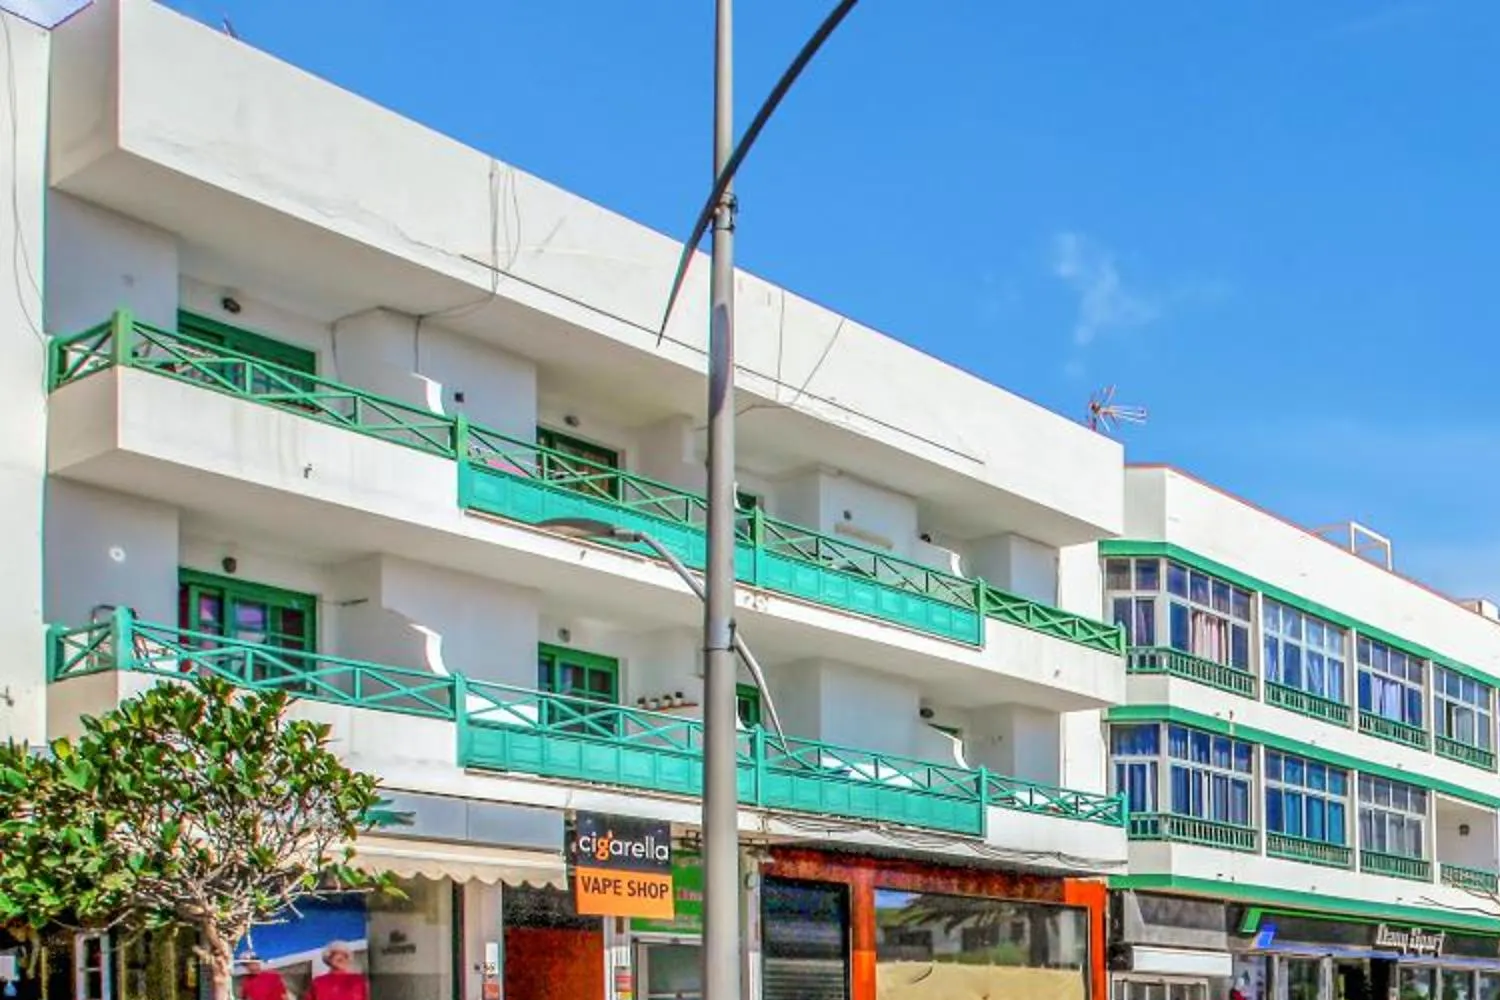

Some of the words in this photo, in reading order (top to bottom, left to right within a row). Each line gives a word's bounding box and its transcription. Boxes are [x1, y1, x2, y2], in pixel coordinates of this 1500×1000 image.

[579, 830, 669, 861] cigarella
[580, 875, 623, 896] VAPE
[627, 879, 669, 899] SHOP
